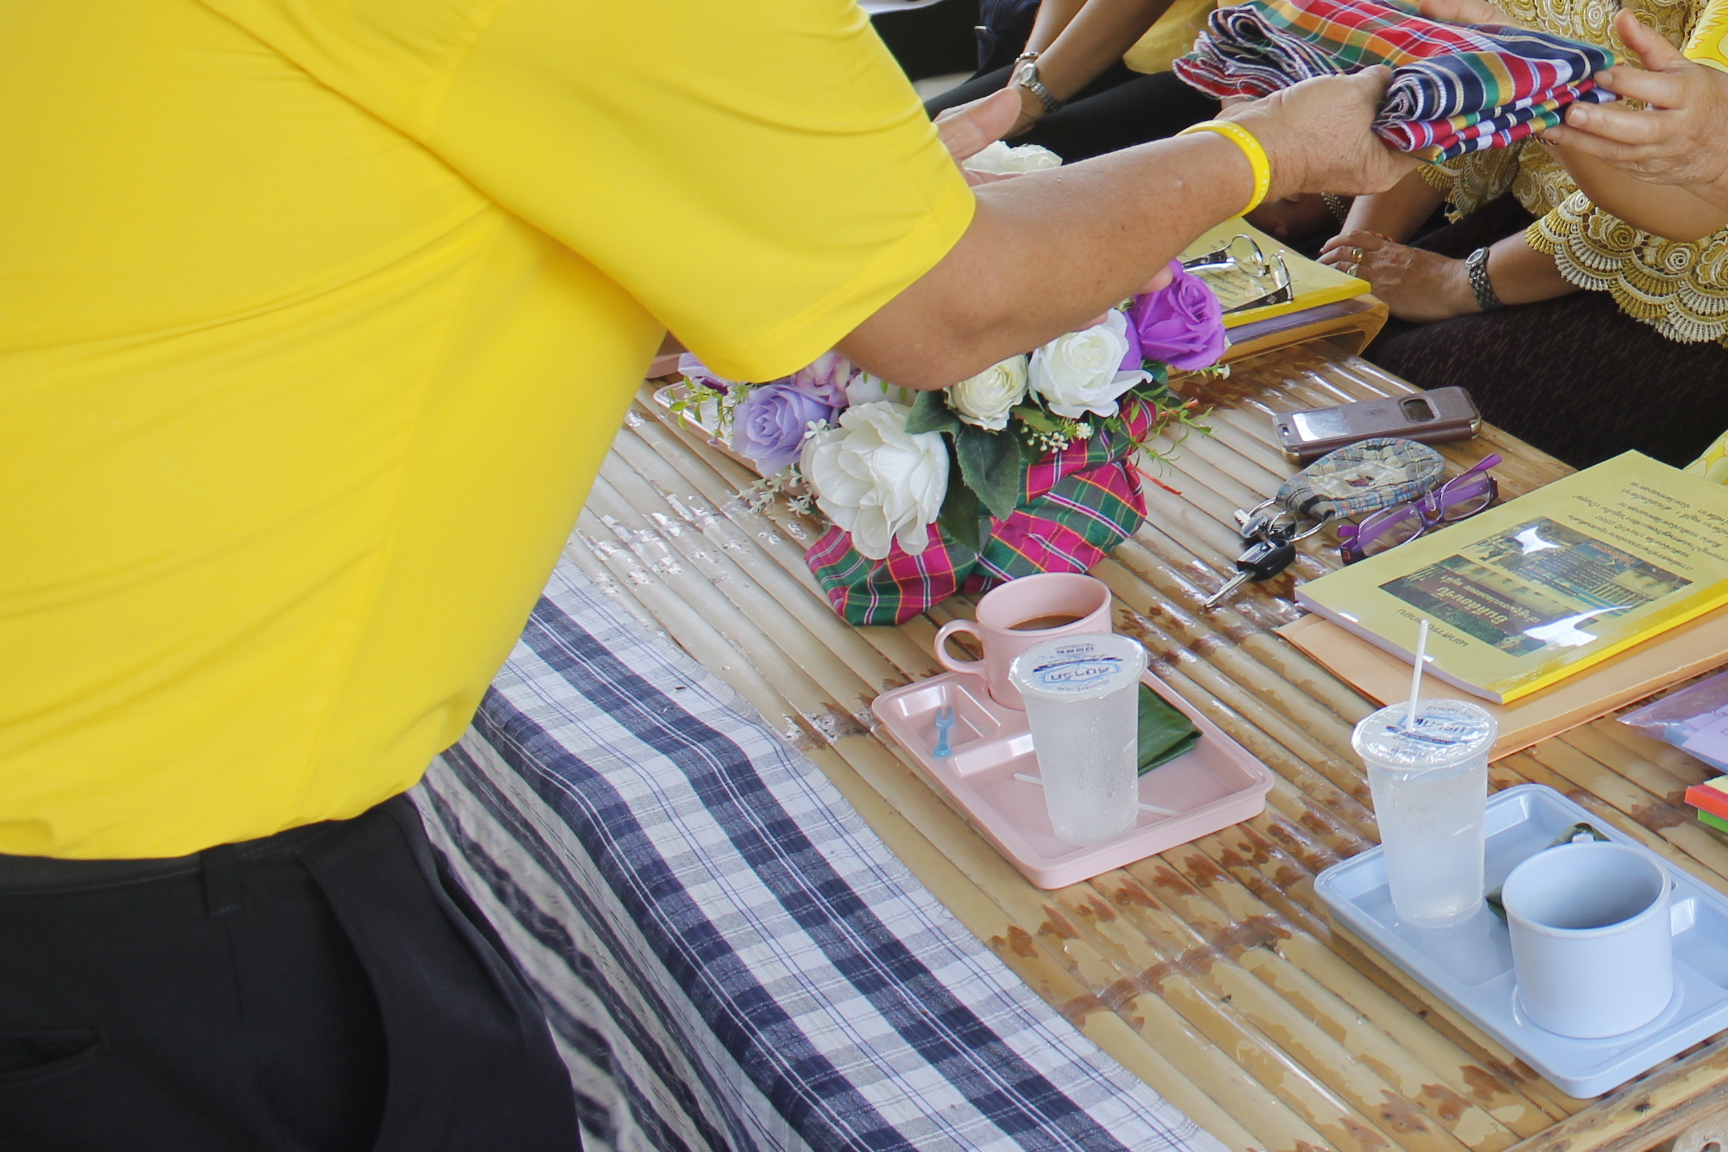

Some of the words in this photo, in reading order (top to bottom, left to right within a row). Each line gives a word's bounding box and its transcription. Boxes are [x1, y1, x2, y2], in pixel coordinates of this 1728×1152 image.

[1432, 587, 1508, 624] ยินดีต้อนรับ
